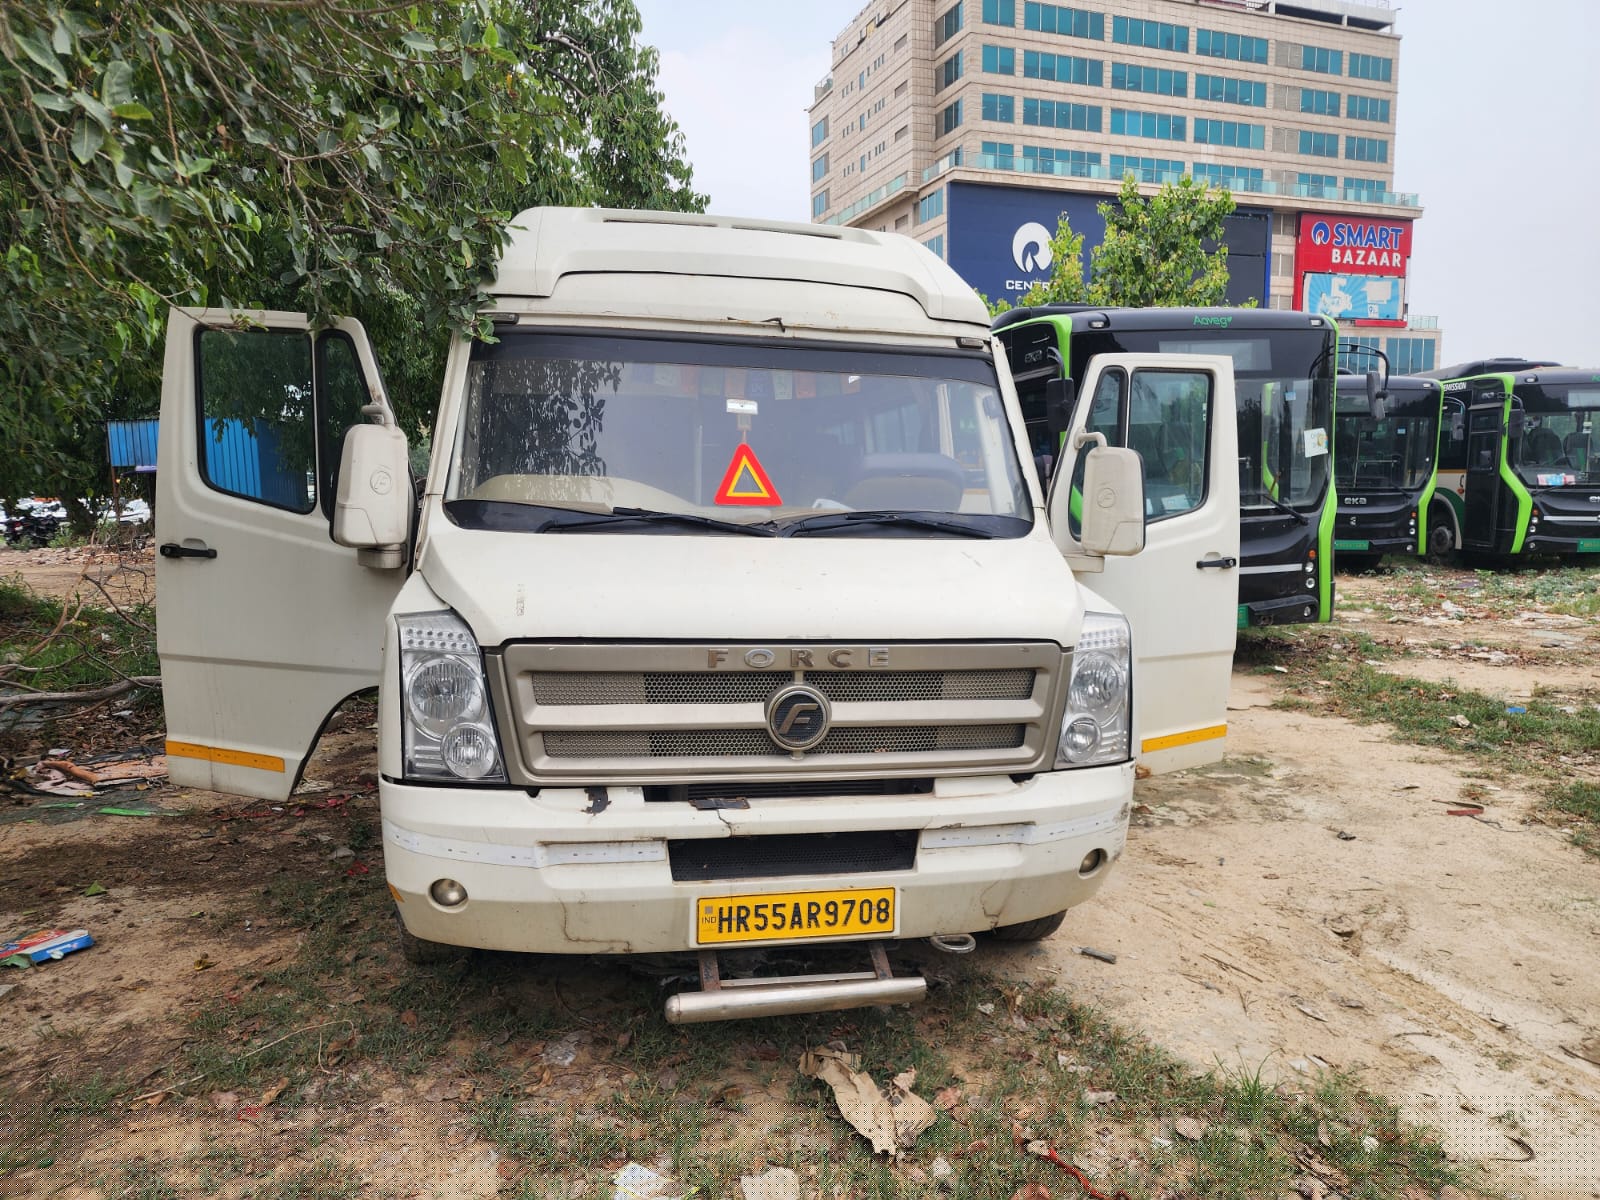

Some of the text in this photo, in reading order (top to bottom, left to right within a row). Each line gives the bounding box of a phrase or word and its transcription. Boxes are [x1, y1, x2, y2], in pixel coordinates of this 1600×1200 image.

[1332, 222, 1404, 250] SMART
[1331, 248, 1402, 268] BAZAAR
[1005, 279, 1060, 292] CENR
[707, 647, 889, 669] FORCE
[701, 898, 889, 933] IND HR55AR9708
